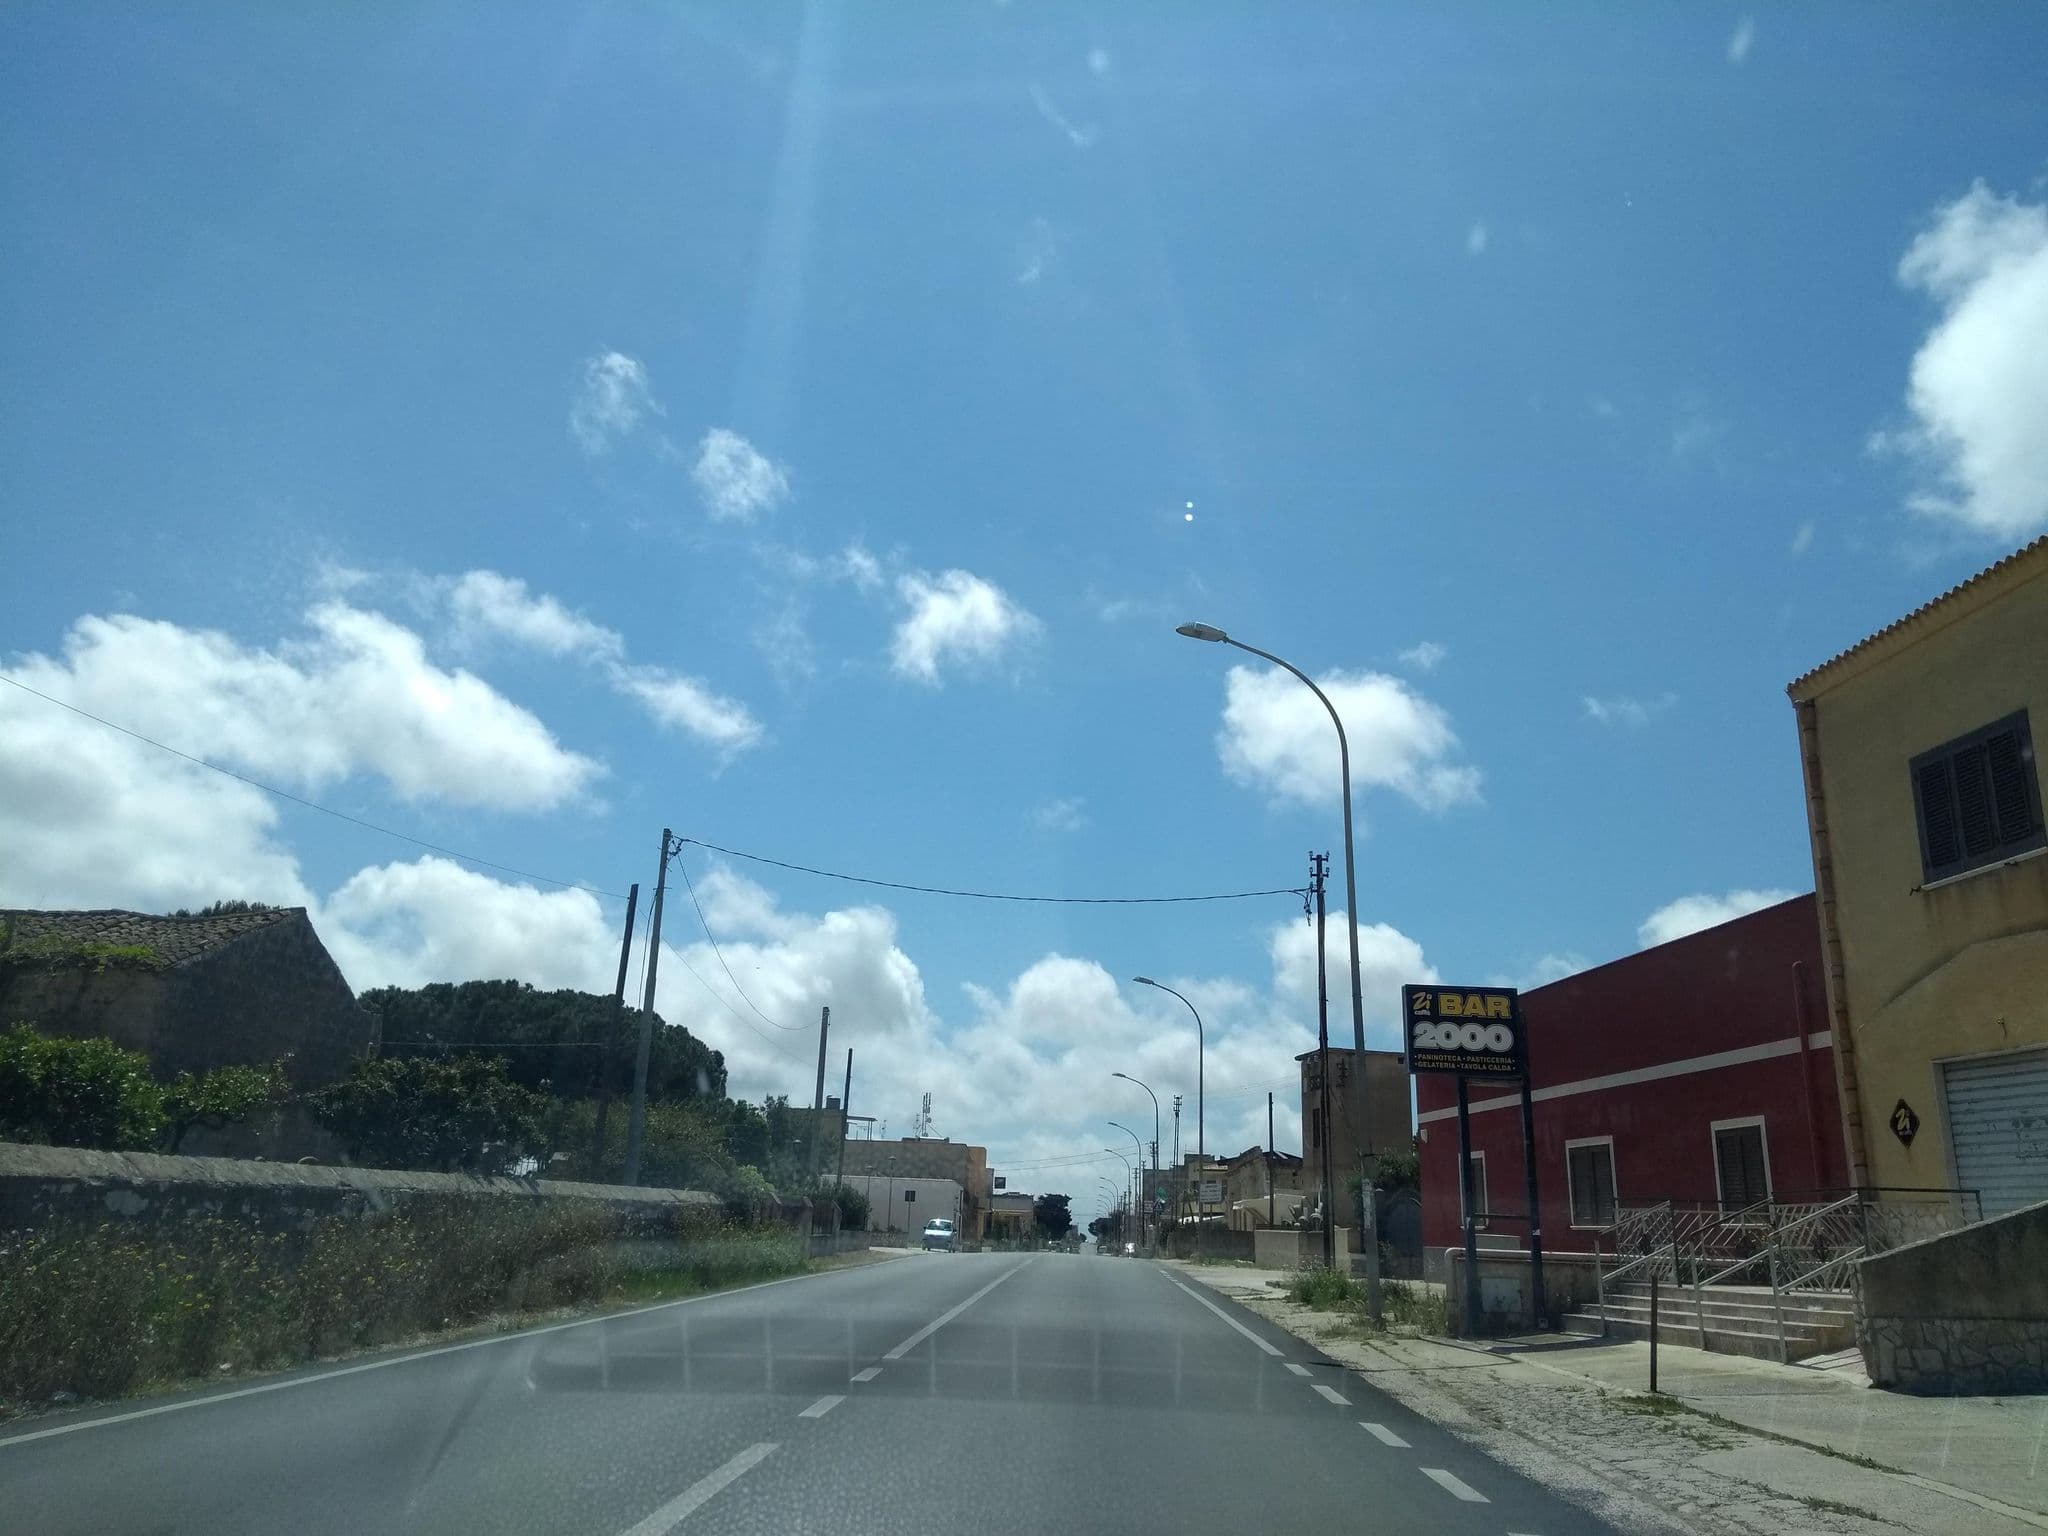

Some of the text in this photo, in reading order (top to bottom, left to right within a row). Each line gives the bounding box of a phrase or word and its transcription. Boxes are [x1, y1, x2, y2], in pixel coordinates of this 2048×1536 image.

[1438, 992, 1512, 1019] BAR
[1413, 1021, 1515, 1053] 2000
[1417, 1054, 1512, 1064] PANINOTECA PASTICCERIA
[1417, 1061, 1456, 1069] GELATERIA
[1460, 1062, 1487, 1070] TAVOLA
